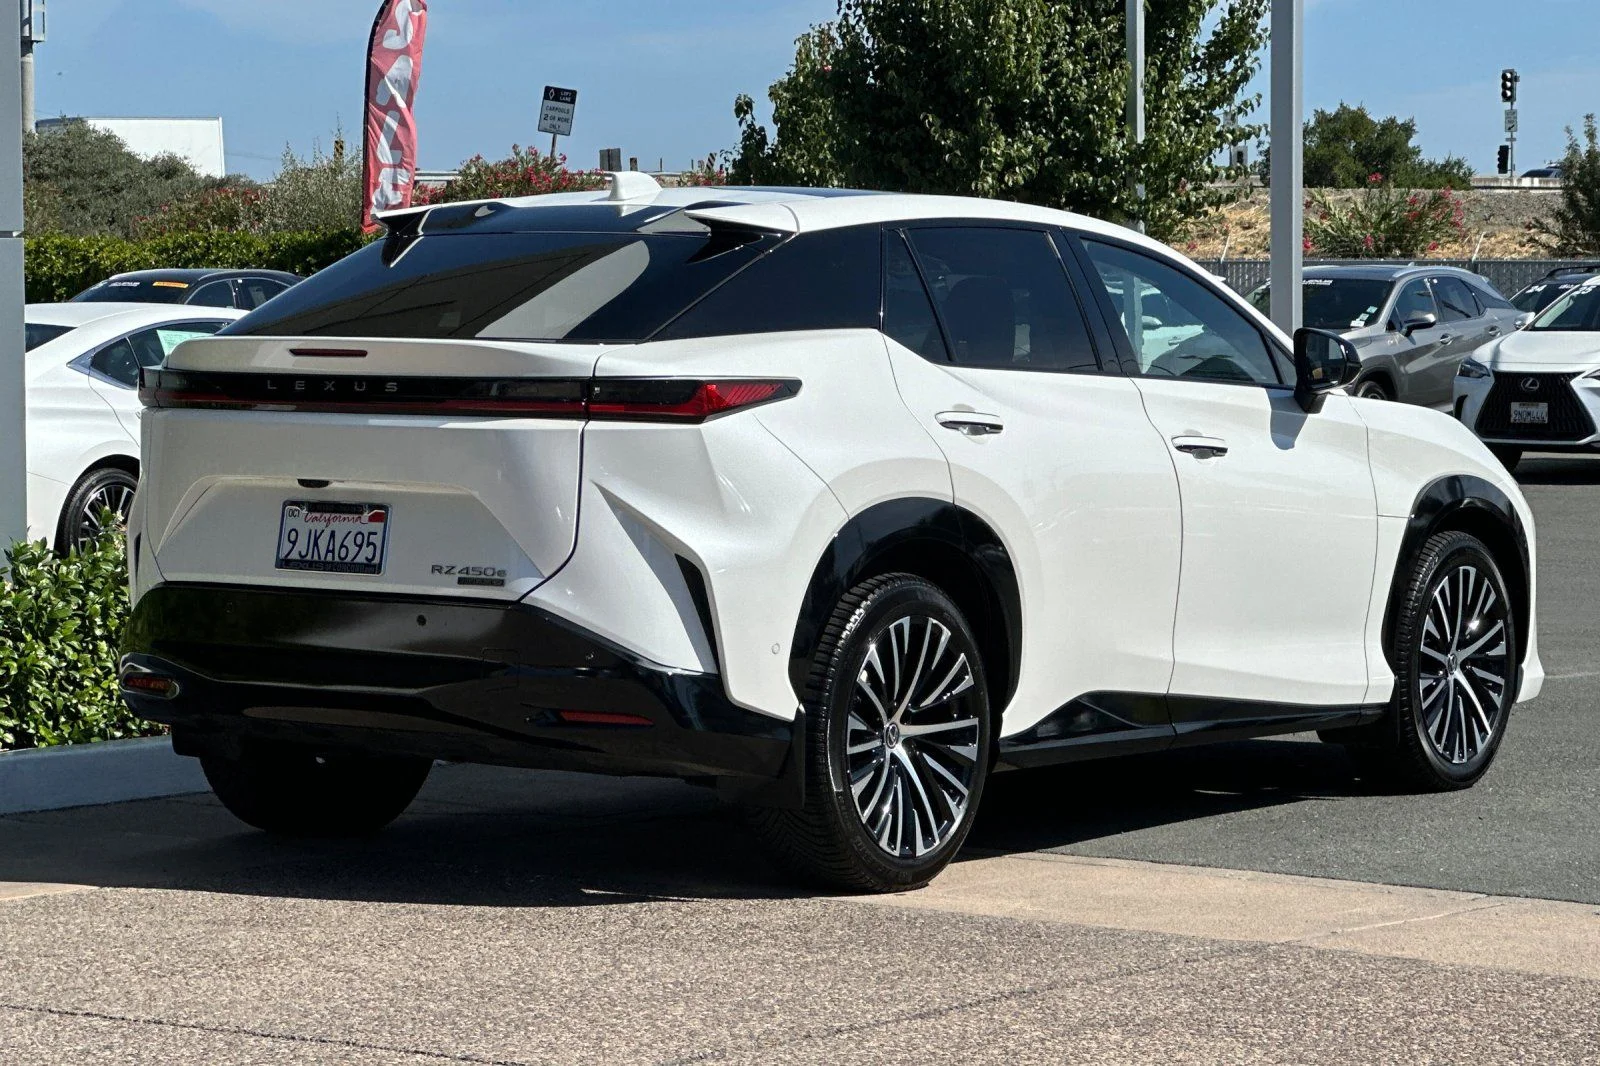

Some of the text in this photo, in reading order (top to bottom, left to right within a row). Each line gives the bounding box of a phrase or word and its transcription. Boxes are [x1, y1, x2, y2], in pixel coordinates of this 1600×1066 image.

[546, 105, 570, 114] CARPOOLS
[267, 379, 398, 392] LEXUS
[304, 512, 368, 528] California
[284, 528, 378, 563] 9JKA695
